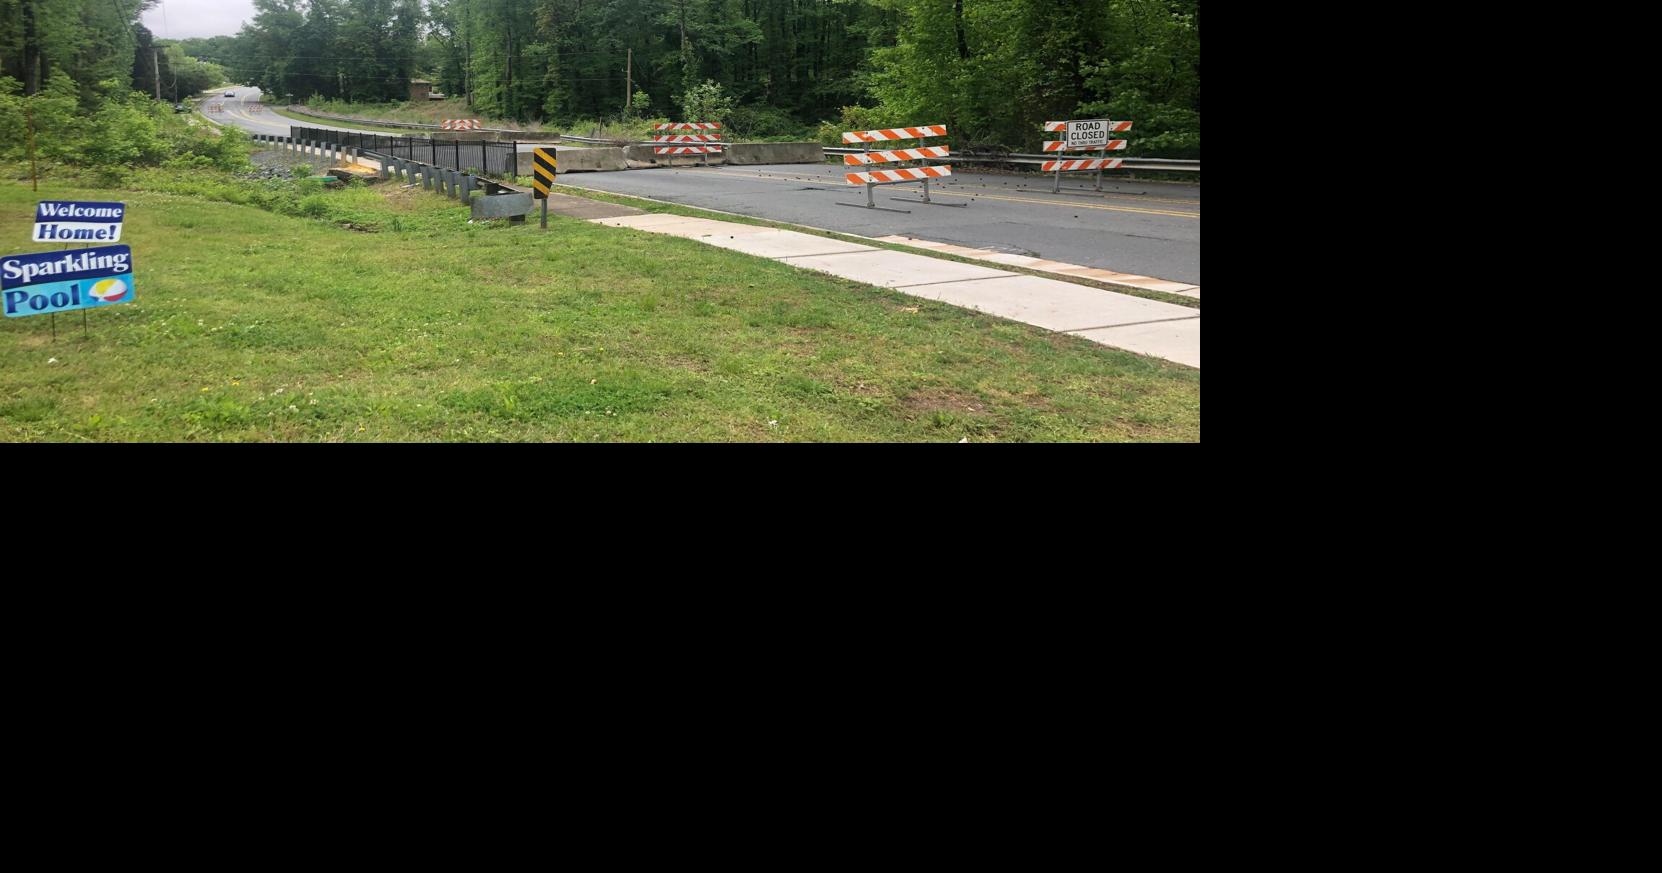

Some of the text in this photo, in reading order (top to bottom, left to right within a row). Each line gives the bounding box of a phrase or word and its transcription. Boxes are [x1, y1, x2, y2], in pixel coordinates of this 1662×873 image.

[1076, 122, 1100, 130] ROAD
[1071, 131, 1104, 140] CLOSED
[39, 203, 122, 218] Welcome
[38, 224, 117, 240] Home!
[2, 252, 129, 283] Sparkling
[5, 284, 80, 314] Pool
